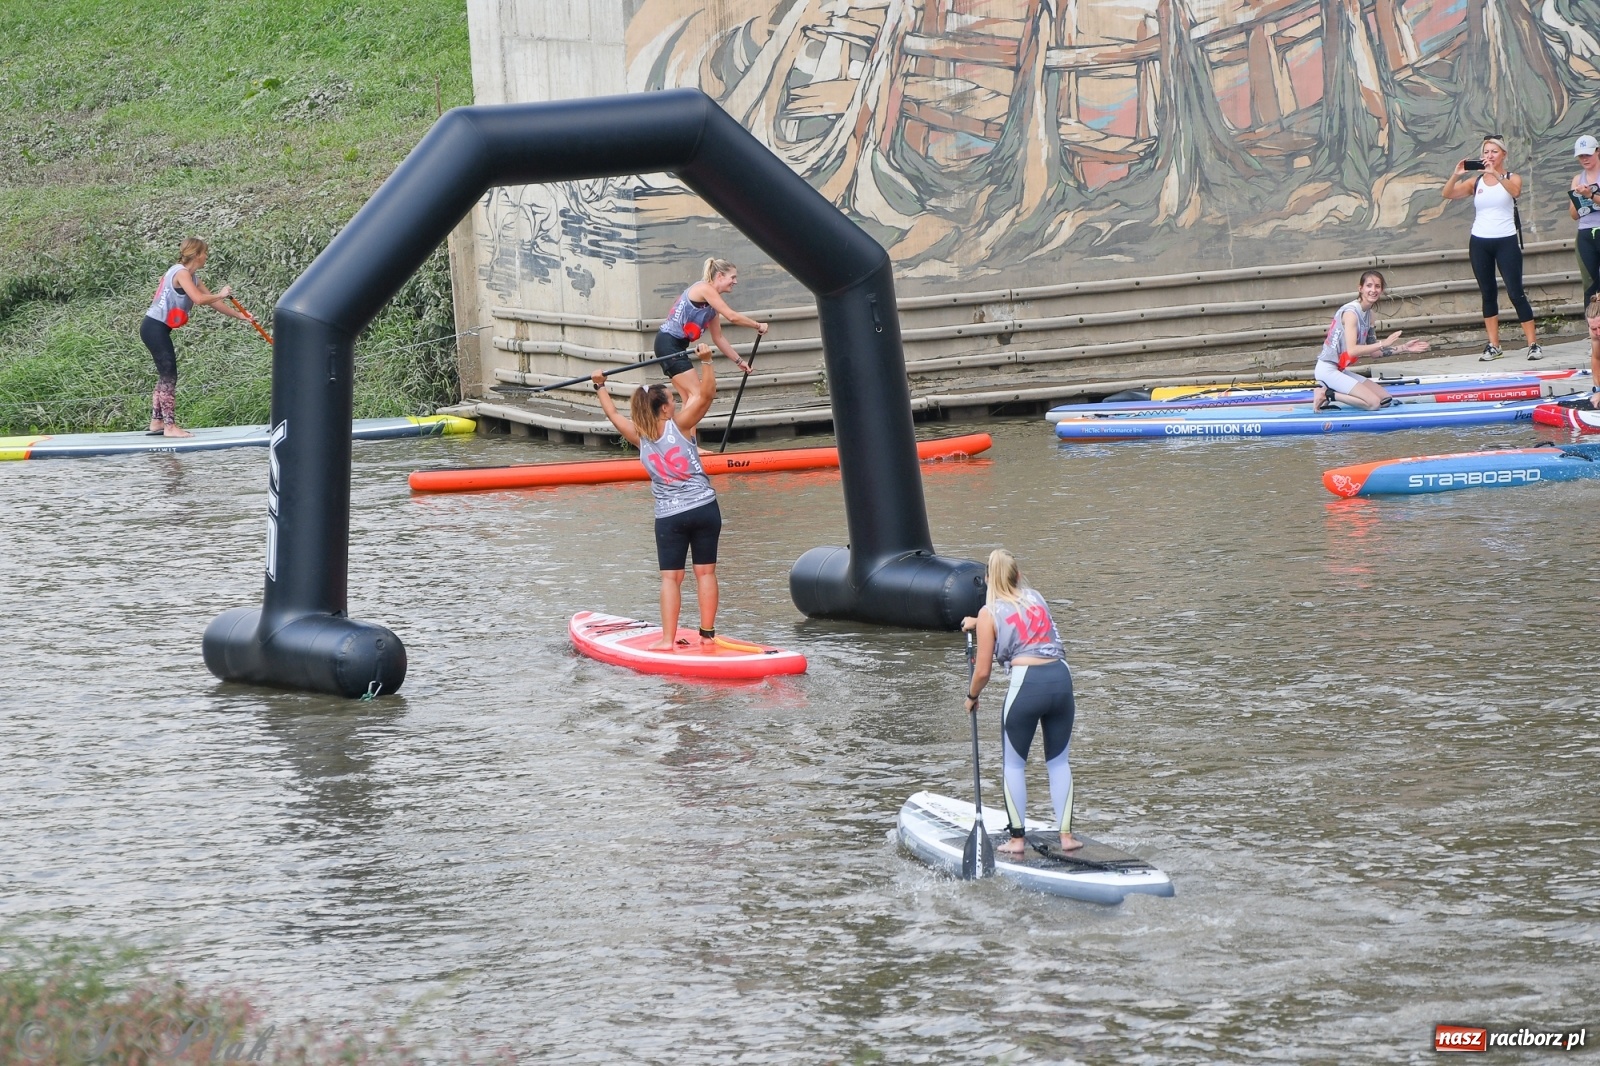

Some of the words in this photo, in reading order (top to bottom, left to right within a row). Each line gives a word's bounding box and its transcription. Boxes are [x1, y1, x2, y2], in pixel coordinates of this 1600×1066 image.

[1164, 422, 1241, 435] COMPETITION
[647, 446, 690, 478] 16
[726, 459, 751, 468] Bass
[1408, 468, 1541, 488] STARBOARD
